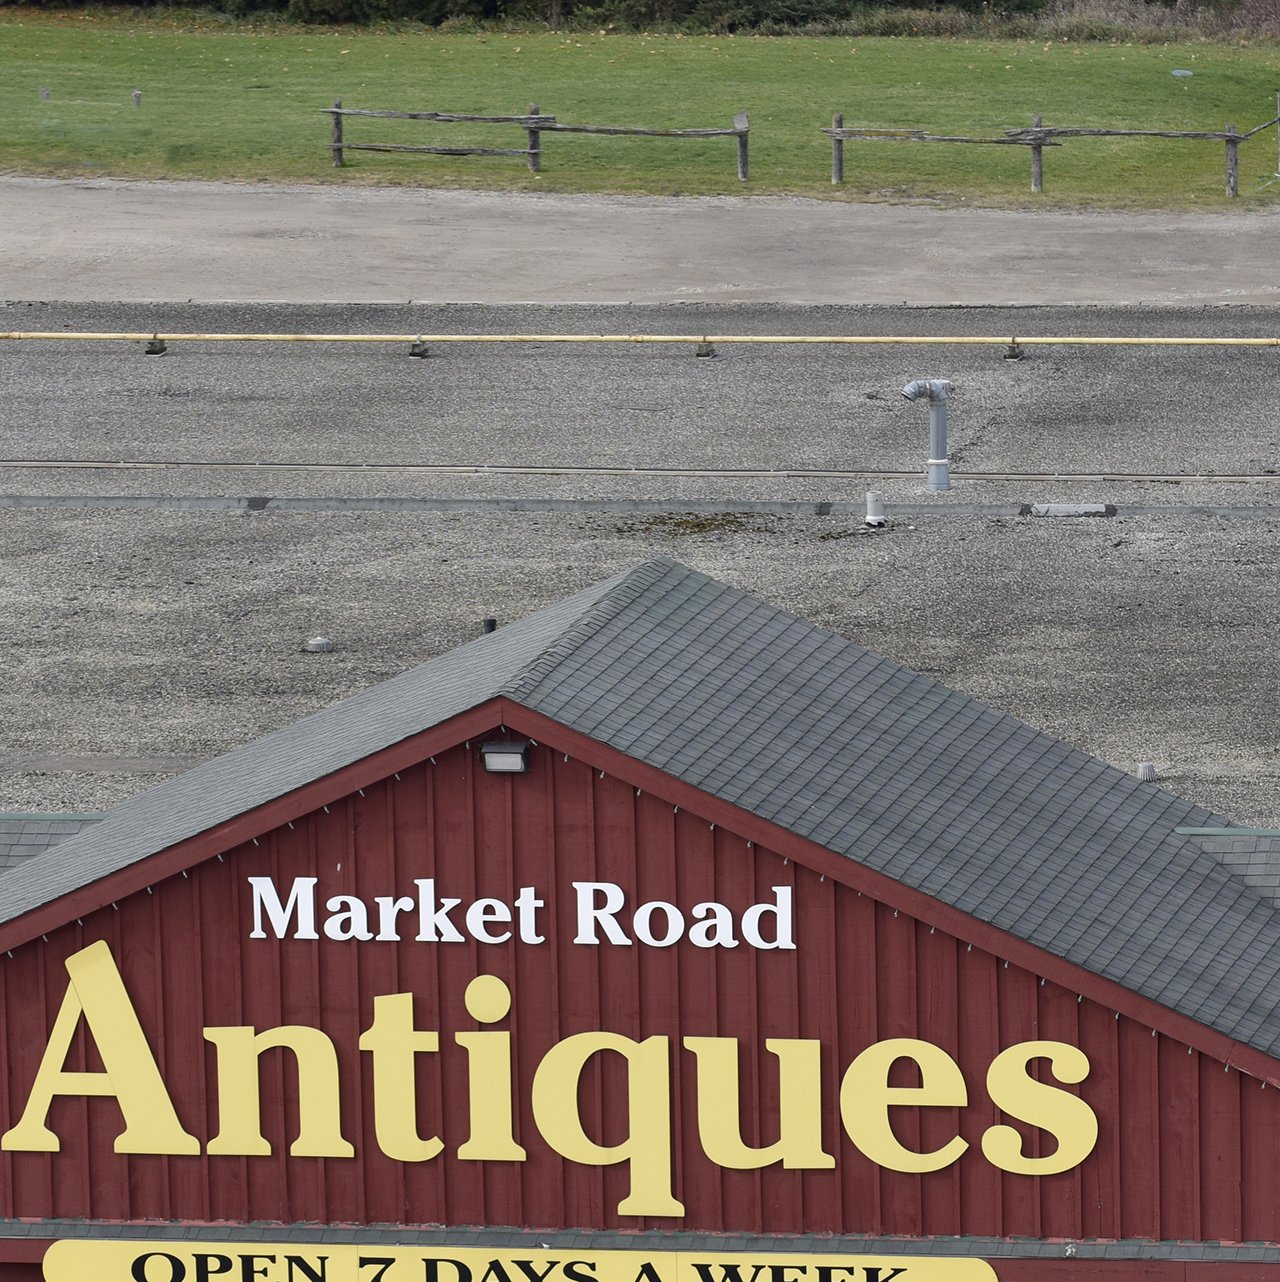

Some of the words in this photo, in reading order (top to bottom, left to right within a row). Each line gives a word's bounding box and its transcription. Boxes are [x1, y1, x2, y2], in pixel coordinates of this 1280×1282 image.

[248, 877, 545, 945] Market
[572, 882, 797, 950] Road
[1, 940, 1099, 1217] Antiques
